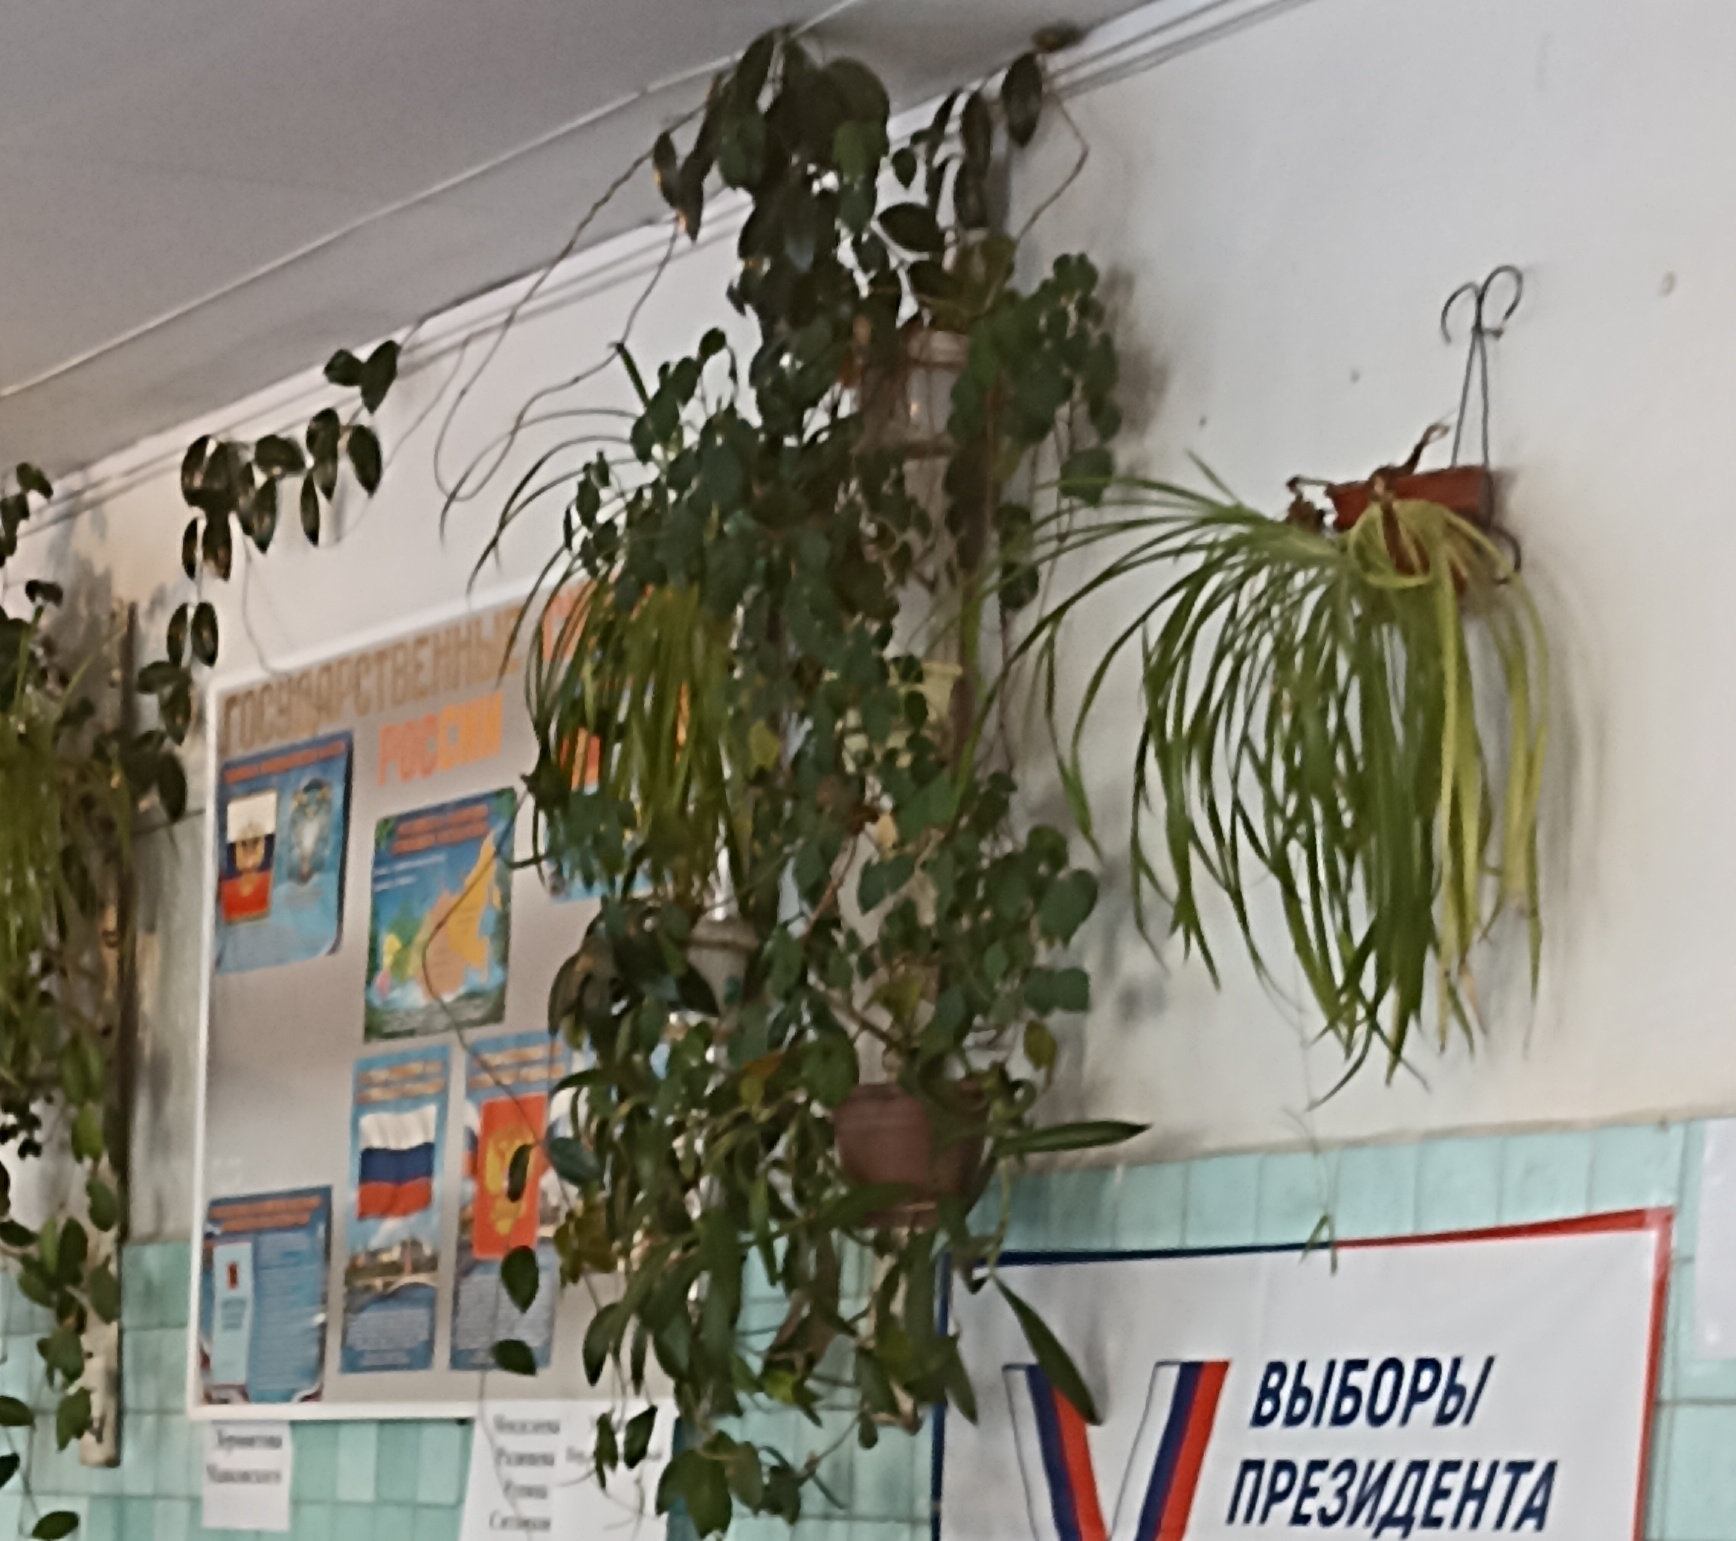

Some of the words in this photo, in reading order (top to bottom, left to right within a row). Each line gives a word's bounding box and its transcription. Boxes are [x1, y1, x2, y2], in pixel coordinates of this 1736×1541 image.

[377, 690, 503, 788] РОССИИ
[1249, 1354, 1497, 1428] ВЫБОРЫ
[1225, 1458, 1558, 1541] ПРЕЗИДЕНТА
